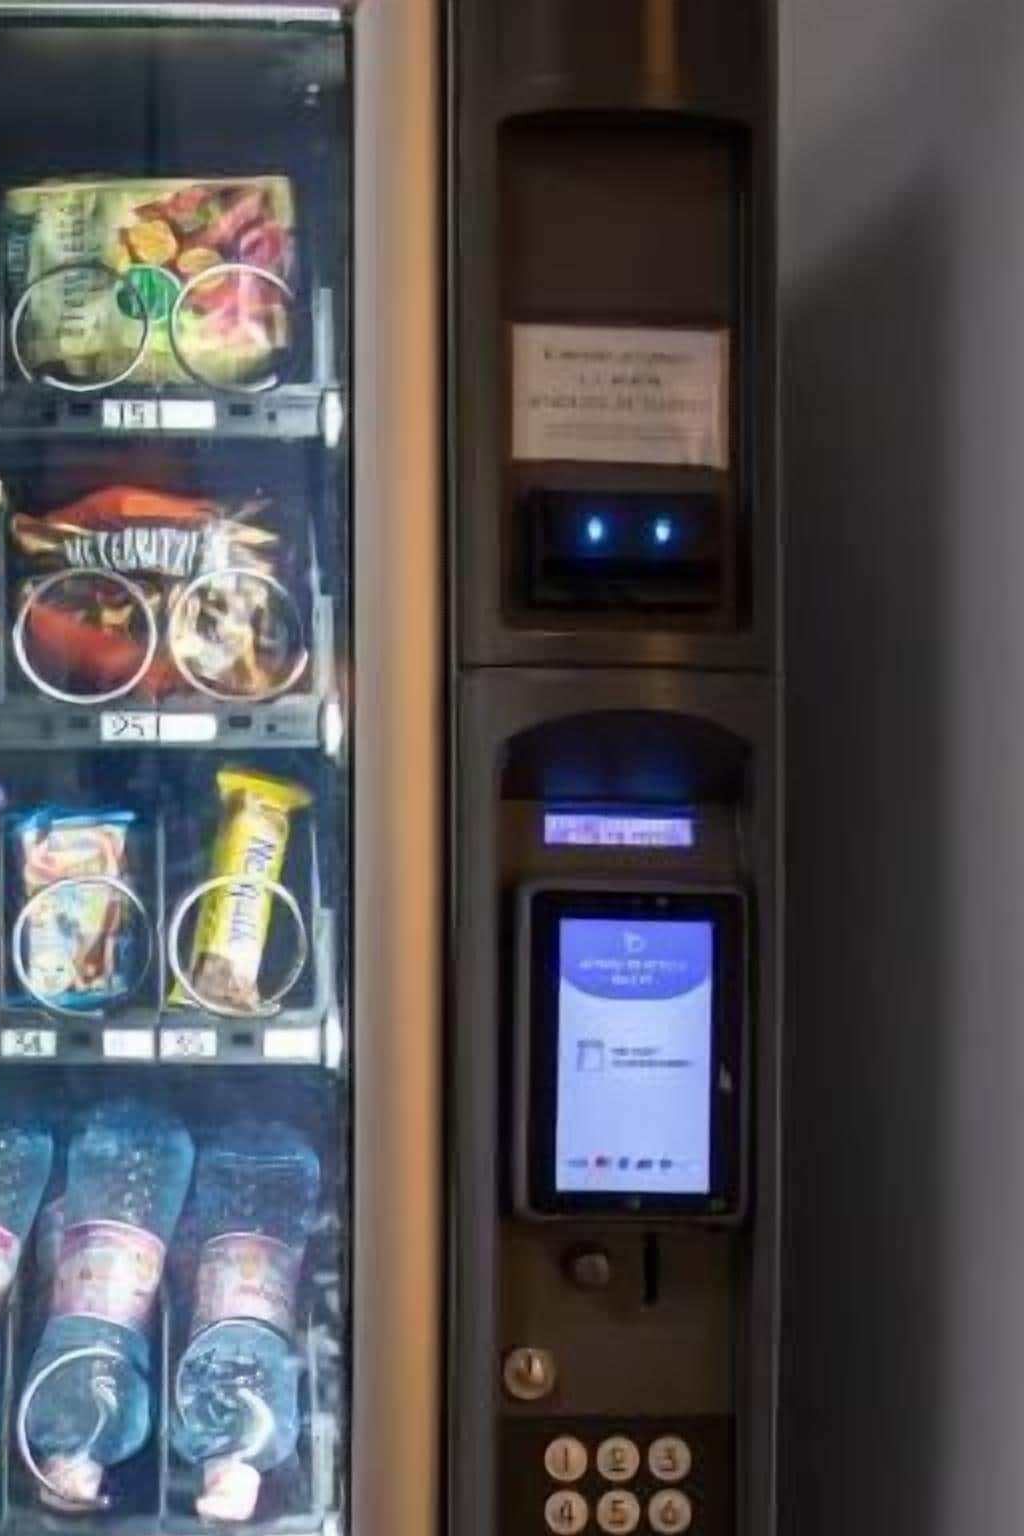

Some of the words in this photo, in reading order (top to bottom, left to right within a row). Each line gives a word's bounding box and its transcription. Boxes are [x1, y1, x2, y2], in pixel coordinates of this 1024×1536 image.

[608, 1446, 627, 1473] 2
[559, 1499, 574, 1528] 4
[608, 1499, 626, 1525] 5
[661, 1499, 679, 1526] 6
